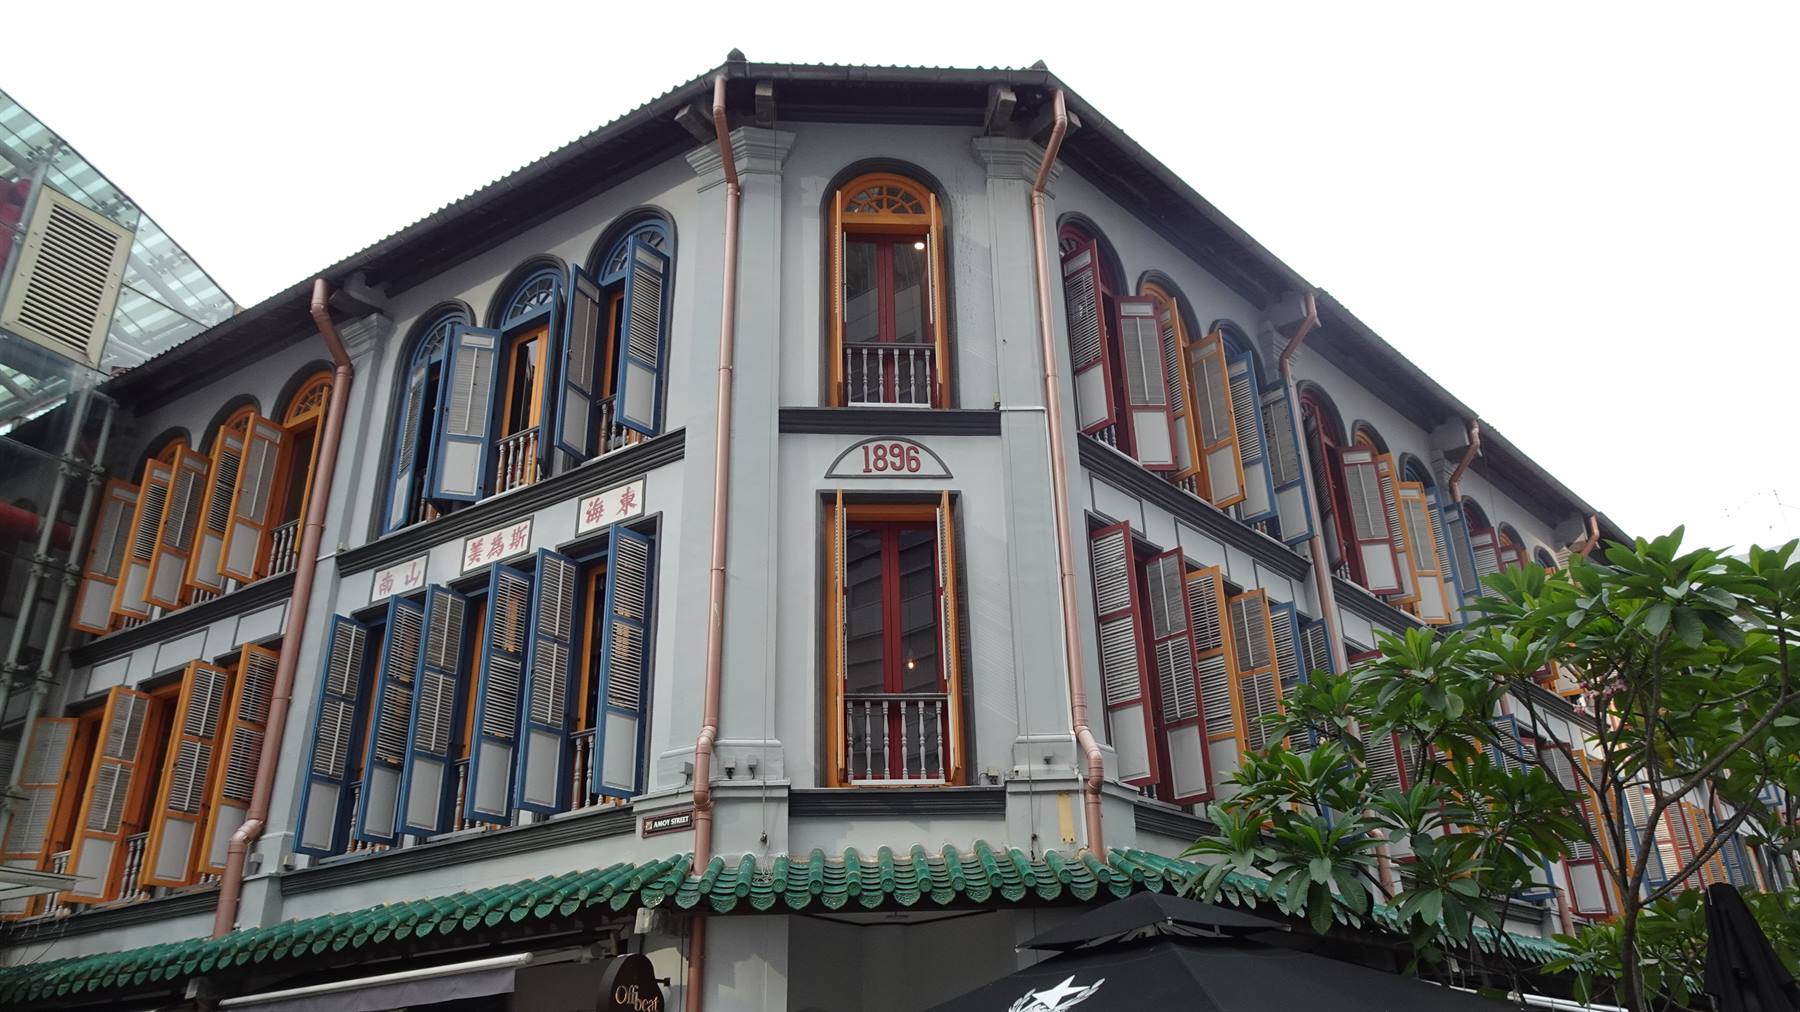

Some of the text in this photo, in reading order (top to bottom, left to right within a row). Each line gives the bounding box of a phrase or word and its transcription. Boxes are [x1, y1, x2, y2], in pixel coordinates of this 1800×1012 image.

[862, 443, 921, 473] 1896
[653, 815, 690, 829] AMOY STREET
